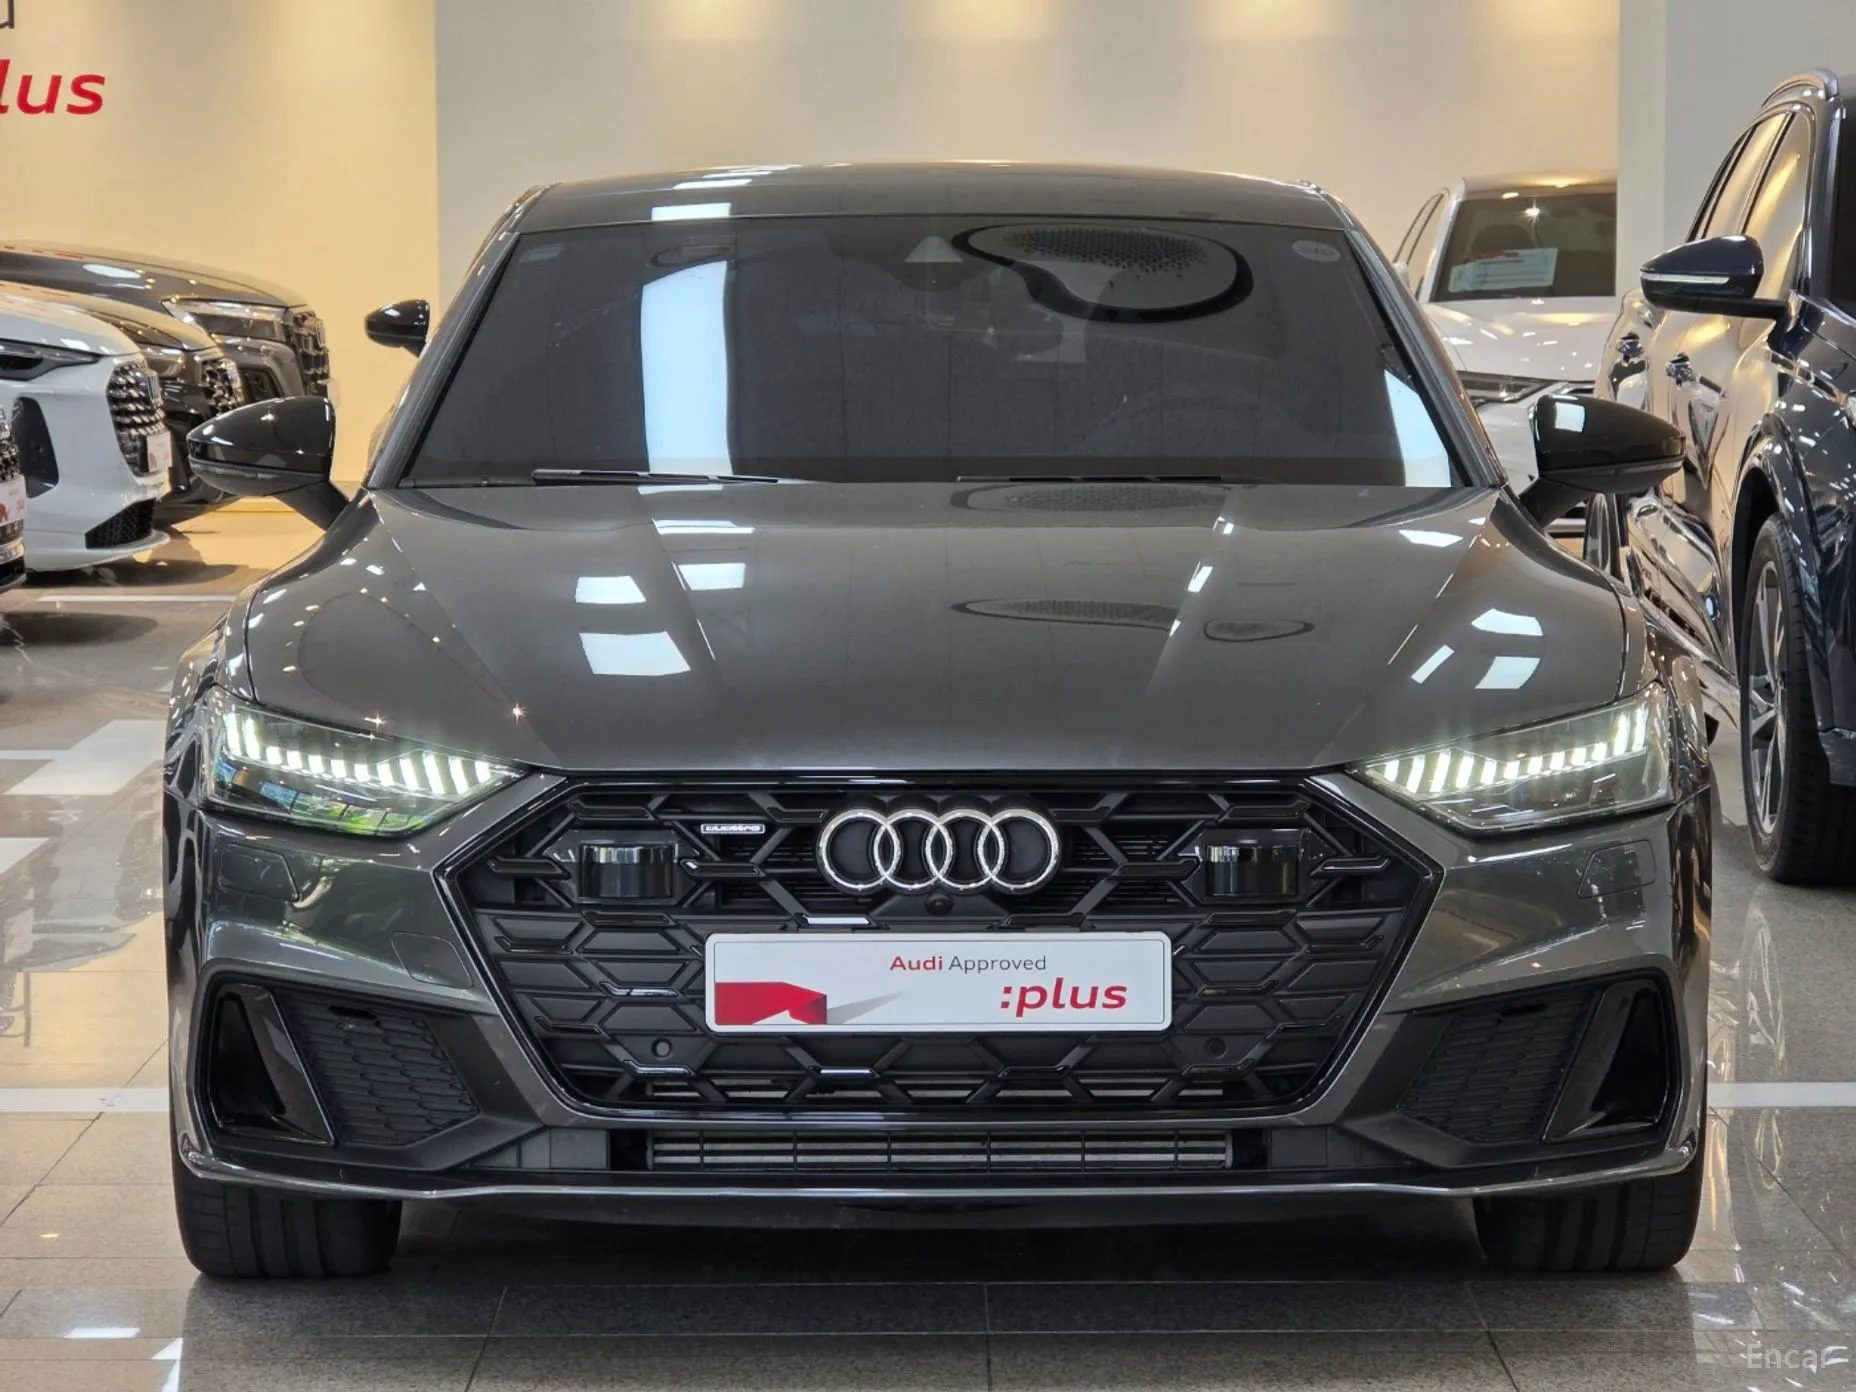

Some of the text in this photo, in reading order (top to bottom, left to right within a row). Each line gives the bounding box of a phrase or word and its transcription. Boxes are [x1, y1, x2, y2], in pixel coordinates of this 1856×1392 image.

[890, 956, 1047, 974] Audi Approved
[1000, 977, 1127, 1018] :plus
